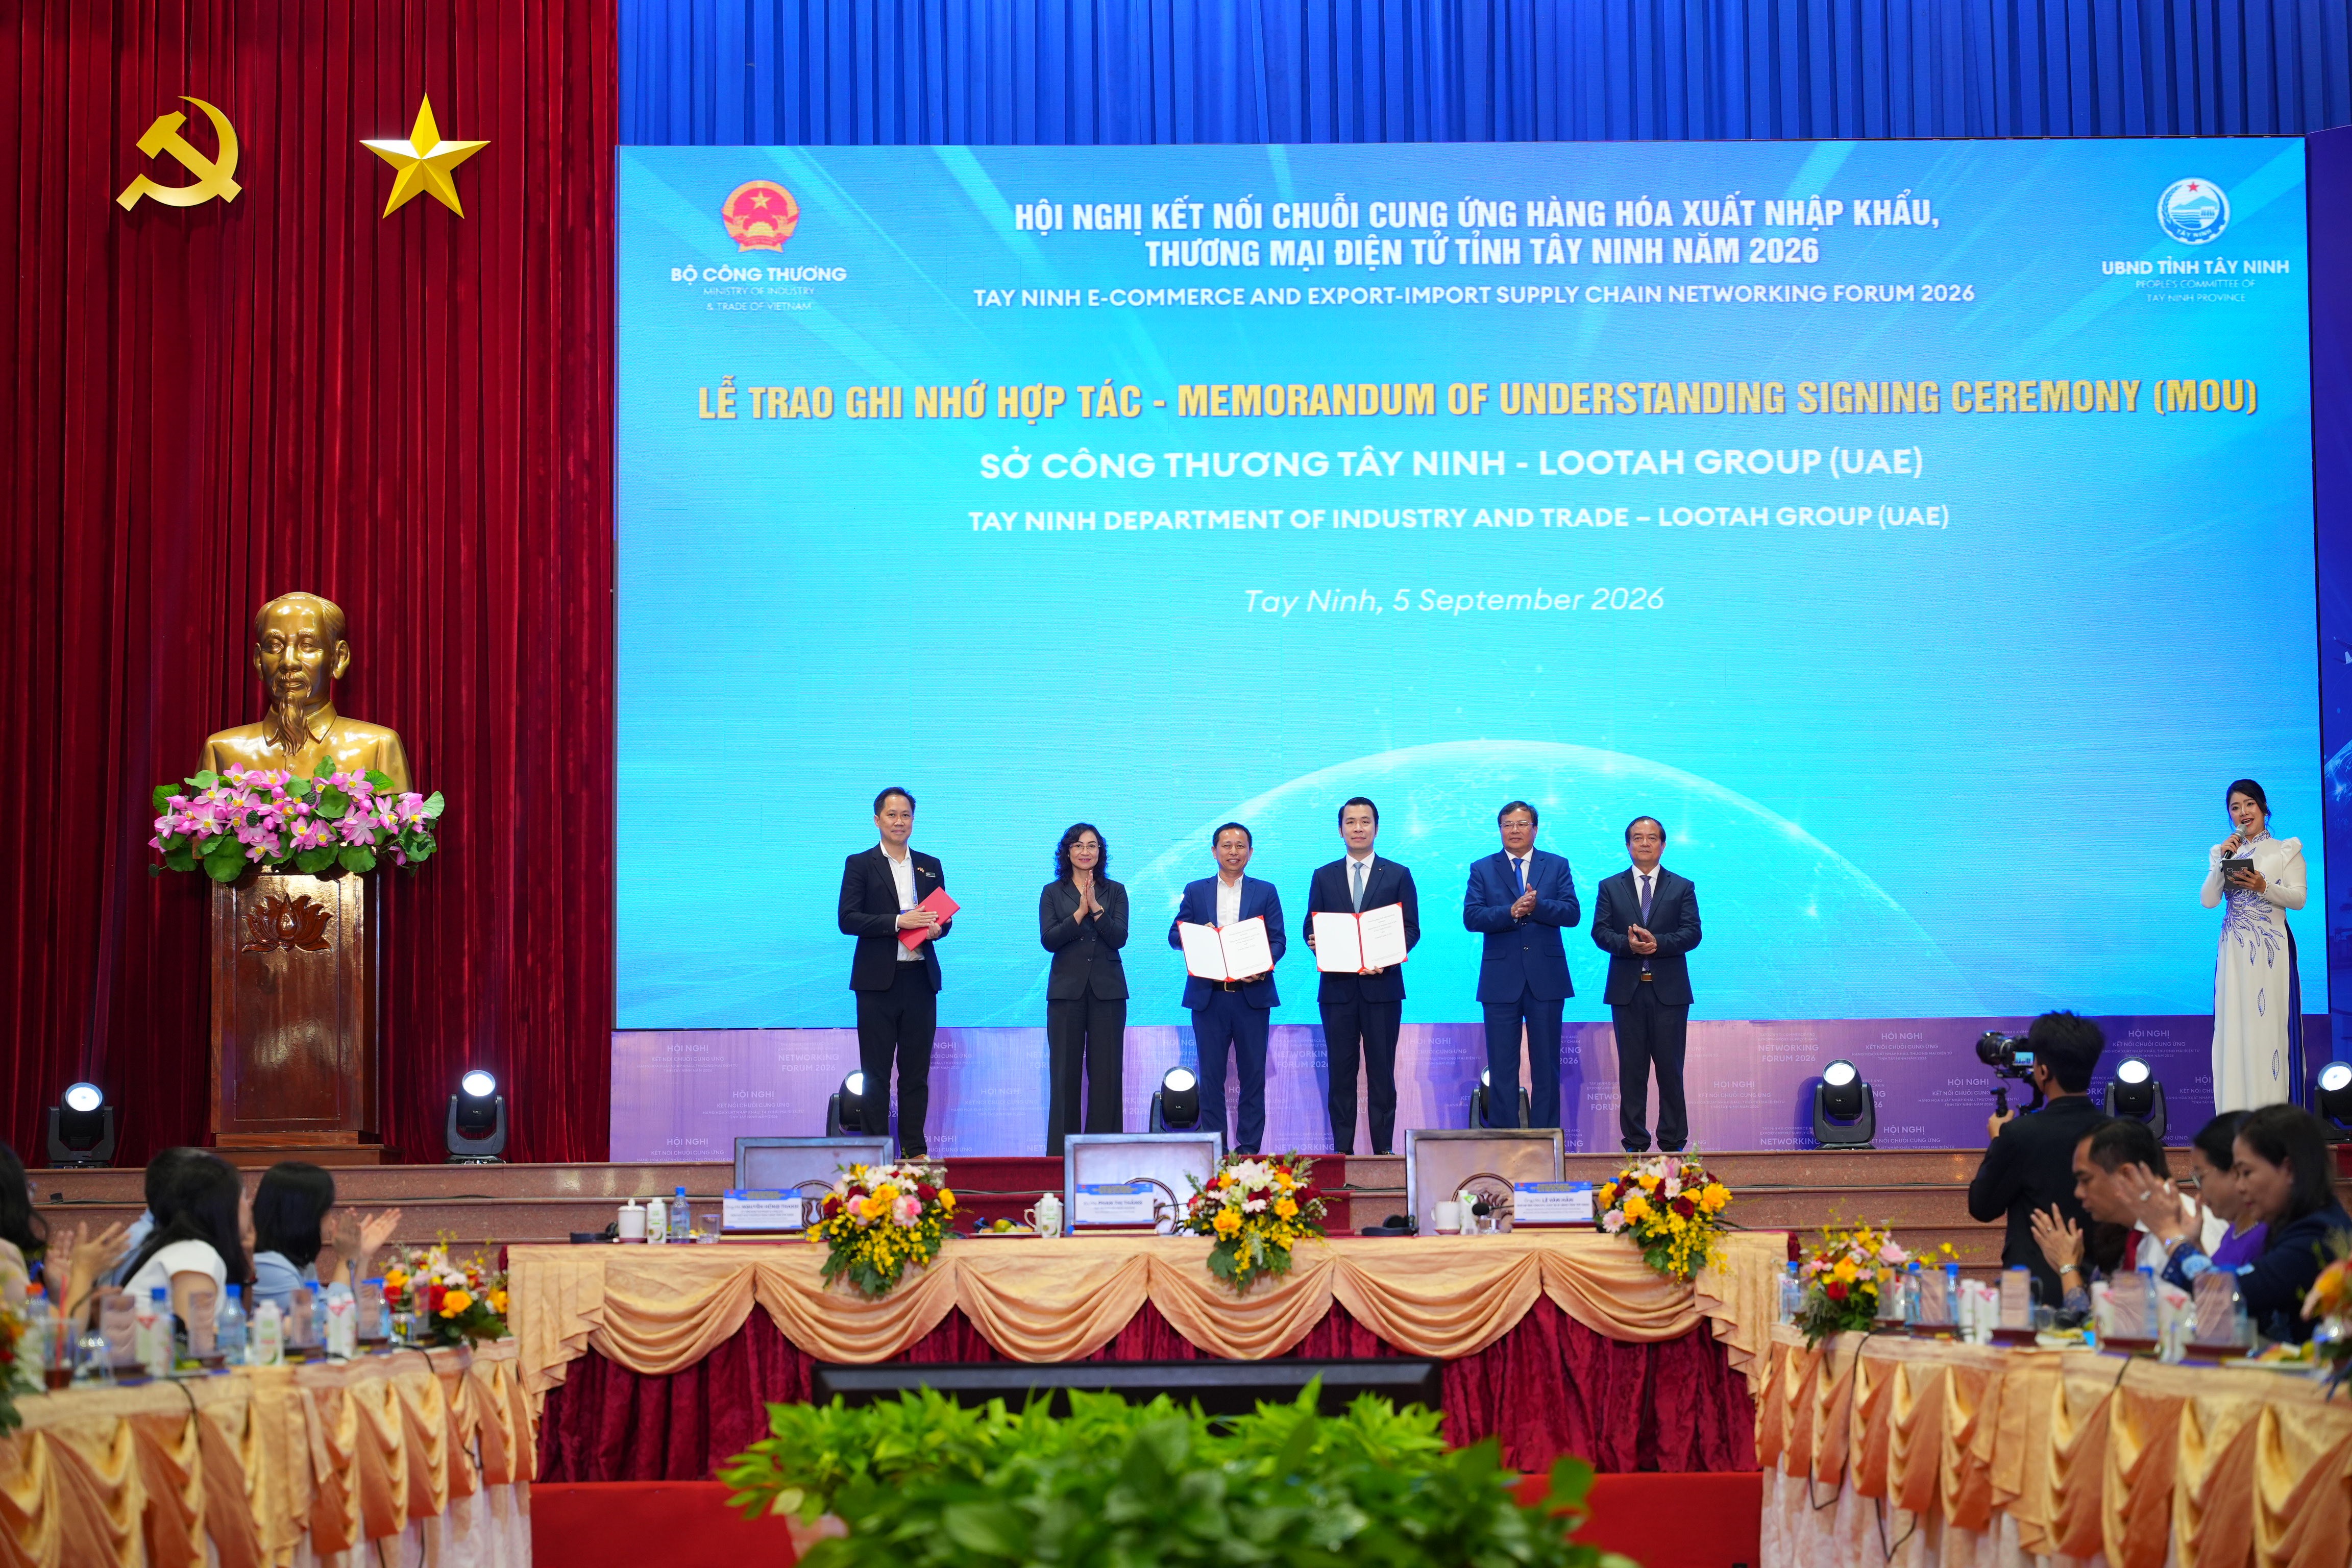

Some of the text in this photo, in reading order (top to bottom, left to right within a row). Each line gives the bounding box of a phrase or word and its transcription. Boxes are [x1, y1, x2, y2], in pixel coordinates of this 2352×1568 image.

[1015, 188, 1939, 236] HỘI NGHỊ KẾT NỐI CHUỖI CUNG ỨNG HÀNG HÓA XUẤT NHẬP KHẨU,
[1145, 229, 1819, 273] THƯƠNG MẠI ĐIỆN TỬ TỈNH TÂY NINH NĂM 2026
[2102, 256, 2290, 275] UBND TỈNH TÂY NINH
[671, 264, 847, 285] BỘ CÔNG THƯƠNG
[2180, 279, 2238, 288] COMMITTEE
[2242, 279, 2256, 287] OF
[703, 287, 748, 296] MINISTRY
[767, 287, 815, 296] INDUSTRY
[973, 284, 1975, 307] TAY NINH E-COMMERCE AND EXPORT-IMPORT SUPPLY CHAIN NETWORKING FORUM 2026
[2147, 293, 2246, 302] TAY NINH PROVINCE
[706, 302, 812, 311] & TRADE OF VIETNAM
[699, 375, 736, 419] LỄ
[748, 386, 833, 419] TRAO
[846, 386, 902, 418] GHI
[915, 378, 987, 418] NHỚ
[997, 382, 1066, 426] HỢP
[1076, 378, 1141, 418] TÁC
[1178, 383, 1435, 416] MEMORANDUM
[1448, 382, 1488, 415] OF
[1500, 381, 1784, 415] UNDERSTANDING
[1797, 380, 1939, 413] SIGNING
[1952, 379, 2141, 412] CEREMONY
[2153, 379, 2257, 415] (MOU)
[980, 445, 1032, 479] SỞ
[1041, 447, 1156, 479] CÔNG
[1163, 451, 1330, 478] THƯƠNG
[1337, 445, 1404, 477] TÂY
[1413, 450, 1505, 476] NINH
[1539, 450, 1684, 475] LOOTAH
[1695, 449, 1822, 474] GROUP
[1830, 446, 1923, 479] (UAE)
[968, 511, 1019, 531] TAY
[1025, 511, 1096, 531] NINH
[1104, 509, 1284, 530] DEPARTMENT
[1290, 509, 1326, 529] OF
[1333, 508, 1467, 529] INDUSTRY
[1473, 508, 1534, 527] AND
[1540, 507, 1629, 527] TRADE
[1659, 507, 1769, 527] LOOTAH
[1776, 506, 1872, 526] GROUP
[1878, 505, 1949, 530] (UAE)
[1245, 587, 1664, 618] Tay Ninh, 5 September 2026
[1881, 1031, 1923, 1041] HỘI NGHỊ
[2128, 1028, 2169, 1039] HỘI NGHỊ
[667, 1043, 708, 1054] HỘI NGHỊ
[1948, 1077, 1989, 1087] HỘI NGHỊ
[733, 1089, 774, 1100] HỘI NGHỊ
[1883, 1124, 1925, 1135] HỘI NGHỊ
[667, 1137, 708, 1147] HỘI NGHỊ
